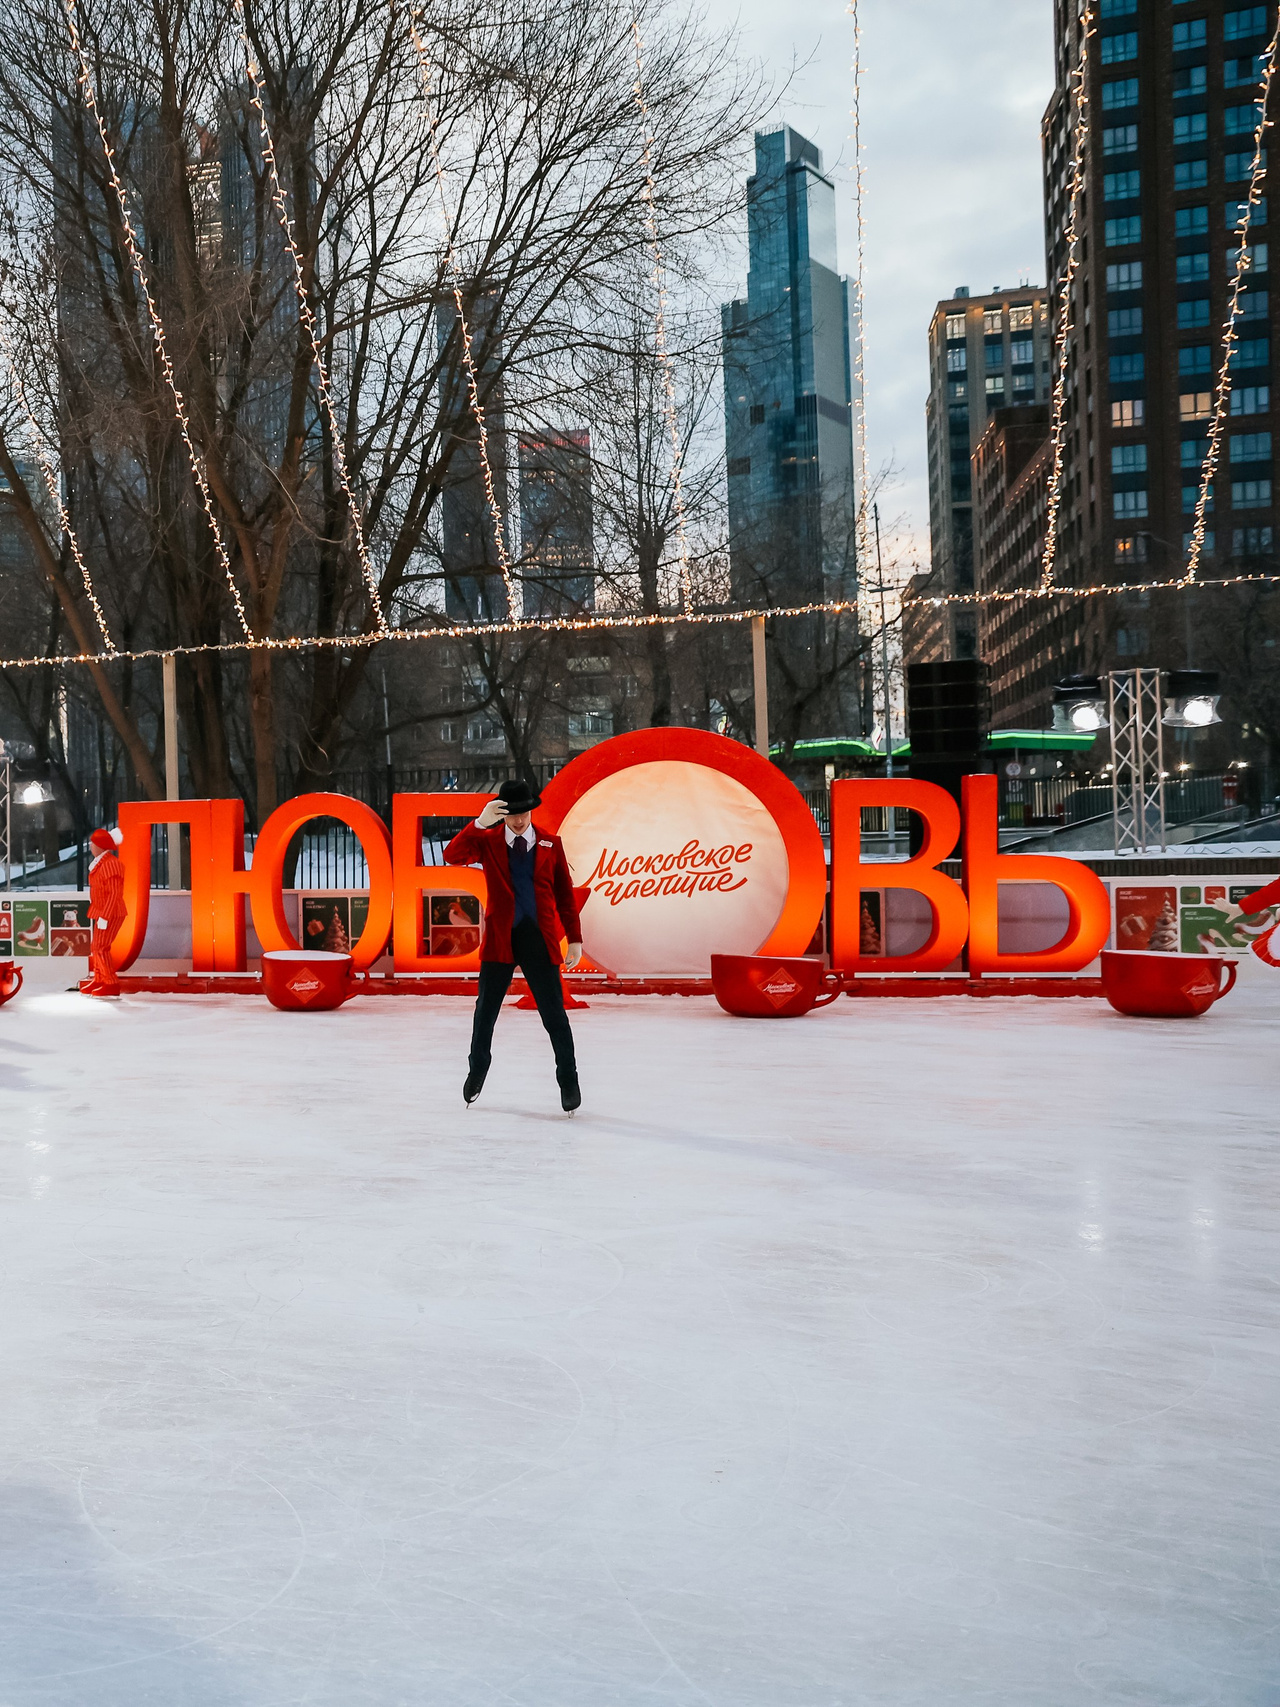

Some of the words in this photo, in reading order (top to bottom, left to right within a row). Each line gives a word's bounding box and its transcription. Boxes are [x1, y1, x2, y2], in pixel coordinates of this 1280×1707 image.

[88, 726, 1111, 973] ЛЮБОВЬ
[581, 839, 753, 888] Московское
[594, 871, 748, 906] чаепитие
